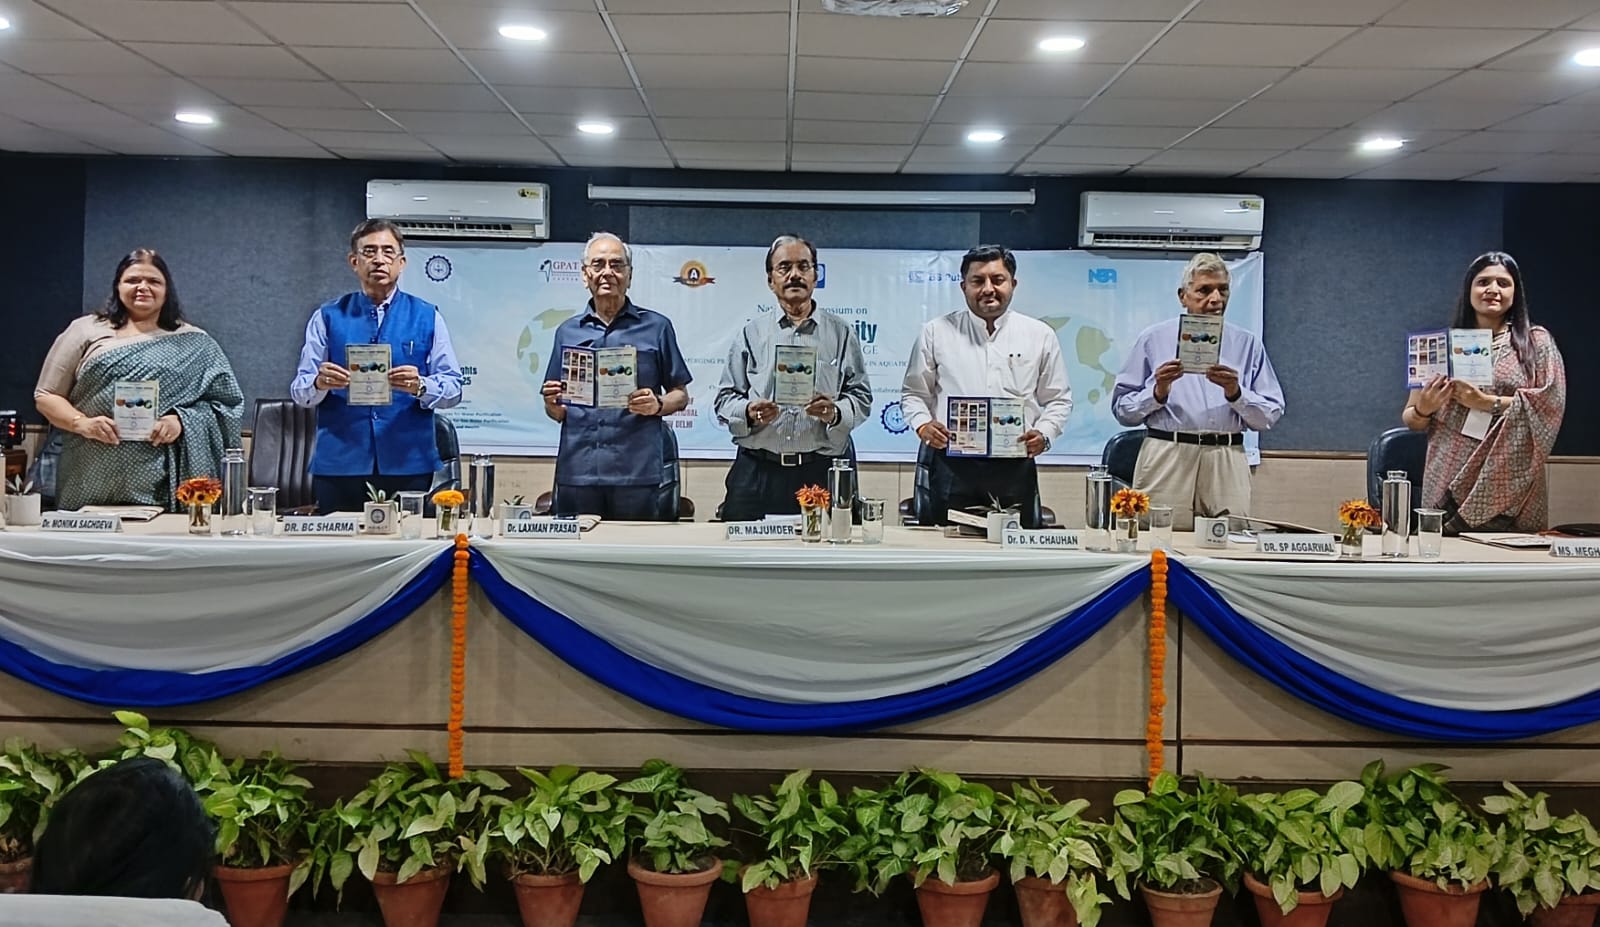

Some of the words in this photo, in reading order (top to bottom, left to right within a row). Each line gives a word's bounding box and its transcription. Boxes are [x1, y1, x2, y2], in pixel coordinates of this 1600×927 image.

[552, 261, 580, 271] GPAT
[856, 320, 878, 343] ity
[862, 345, 878, 355] GE
[460, 366, 477, 375] ghts
[42, 518, 50, 528] Dr.
[52, 519, 78, 529] MONIKA
[78, 519, 113, 530] SACHDEVA
[284, 522, 299, 532] DR.
[301, 522, 314, 532] BC
[316, 522, 354, 532] SHARMA
[507, 523, 516, 533] Dr.
[518, 523, 548, 533] LAXMAN
[549, 524, 577, 533] PRASAD
[728, 526, 743, 535] DR.
[745, 525, 794, 535] MAJUMDER
[1007, 536, 1018, 544] Dr.
[1020, 536, 1027, 544] D.
[1029, 536, 1038, 544] K.
[1039, 535, 1078, 545] CHAUHAN
[1263, 543, 1277, 552] DR.
[1279, 542, 1290, 552] SP
[1291, 543, 1334, 552] AGGARWAL
[1558, 546, 1574, 556] MS.
[1575, 546, 1600, 557] MEGH
